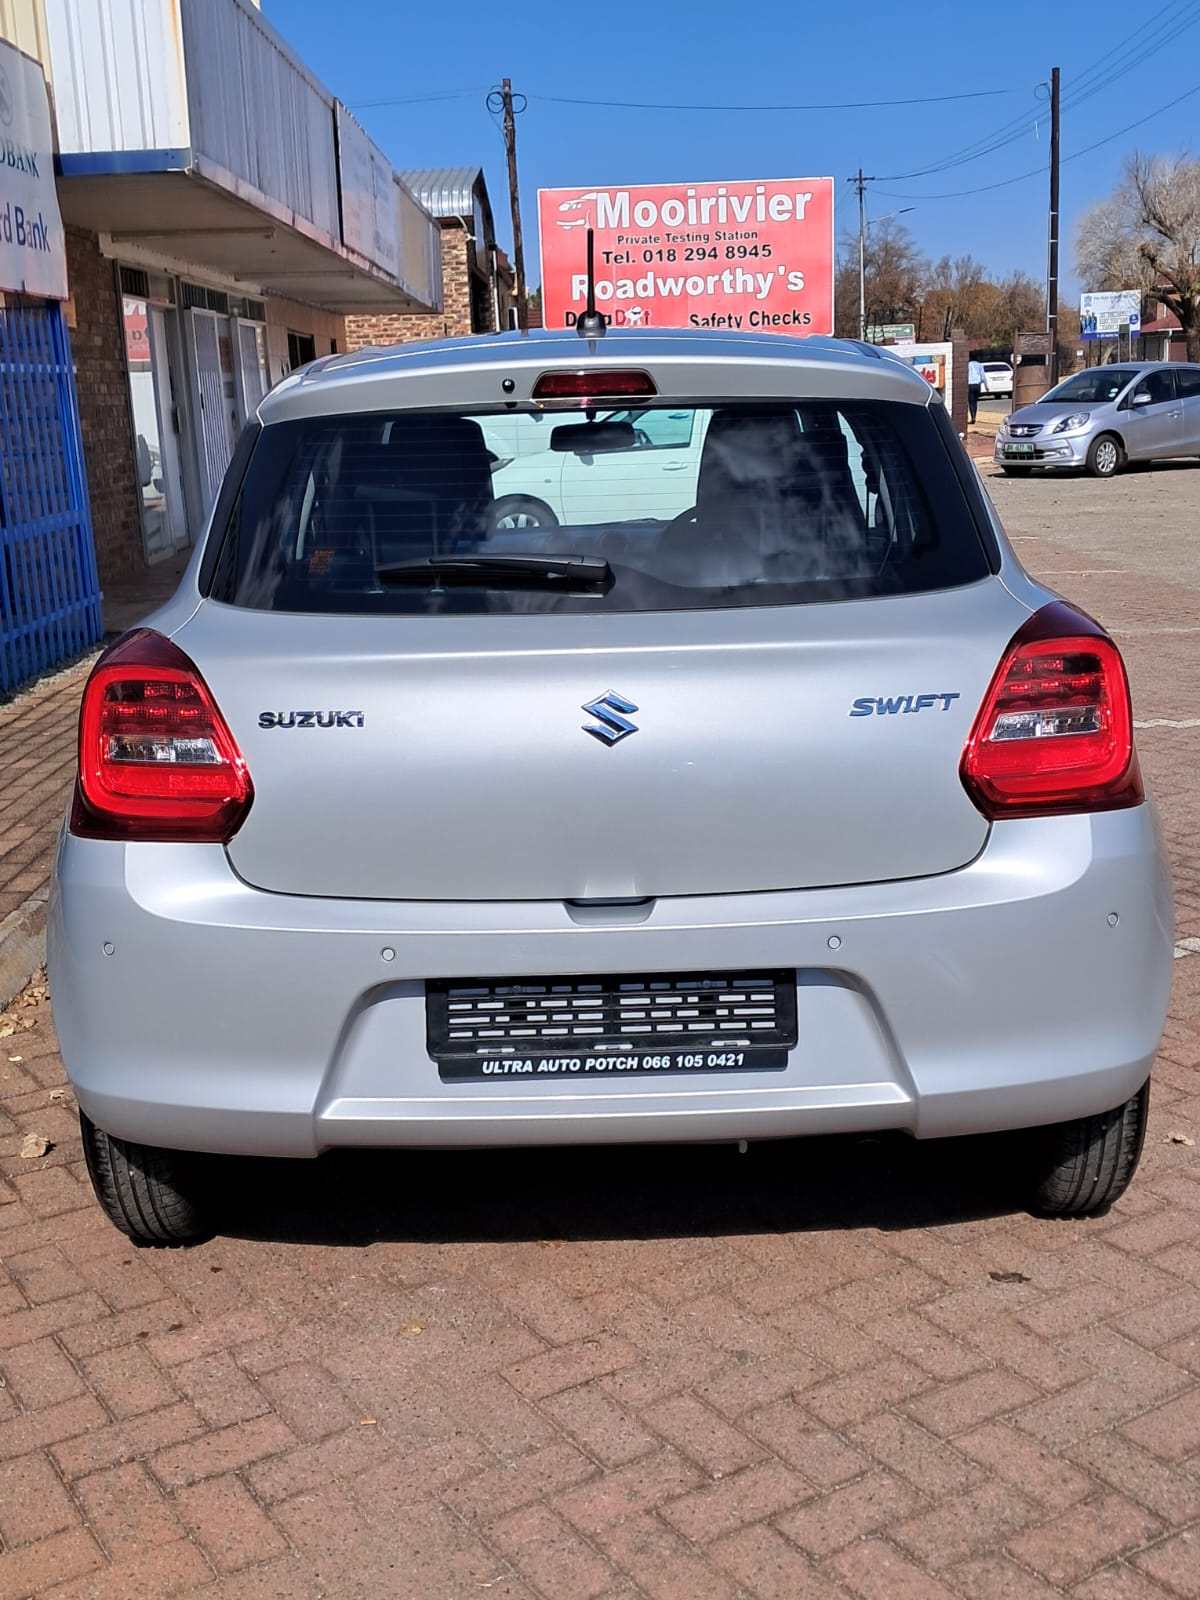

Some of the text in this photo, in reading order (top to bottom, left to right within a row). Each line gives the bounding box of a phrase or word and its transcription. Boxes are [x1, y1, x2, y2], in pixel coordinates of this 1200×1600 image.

[597, 185, 812, 230] Mooirivier
[15, 205, 51, 253] Bank
[617, 230, 758, 245] Private Testing Station
[602, 244, 772, 265] Tel. 018 294 8945
[571, 265, 805, 301] Roadworthy's
[689, 312, 743, 329] Safety
[749, 309, 811, 327] Checks
[849, 692, 960, 716] SWIFT
[258, 711, 365, 729] SUZUKI
[482, 1053, 745, 1074] ULTRA AUTO POTCH 066 105 0421
